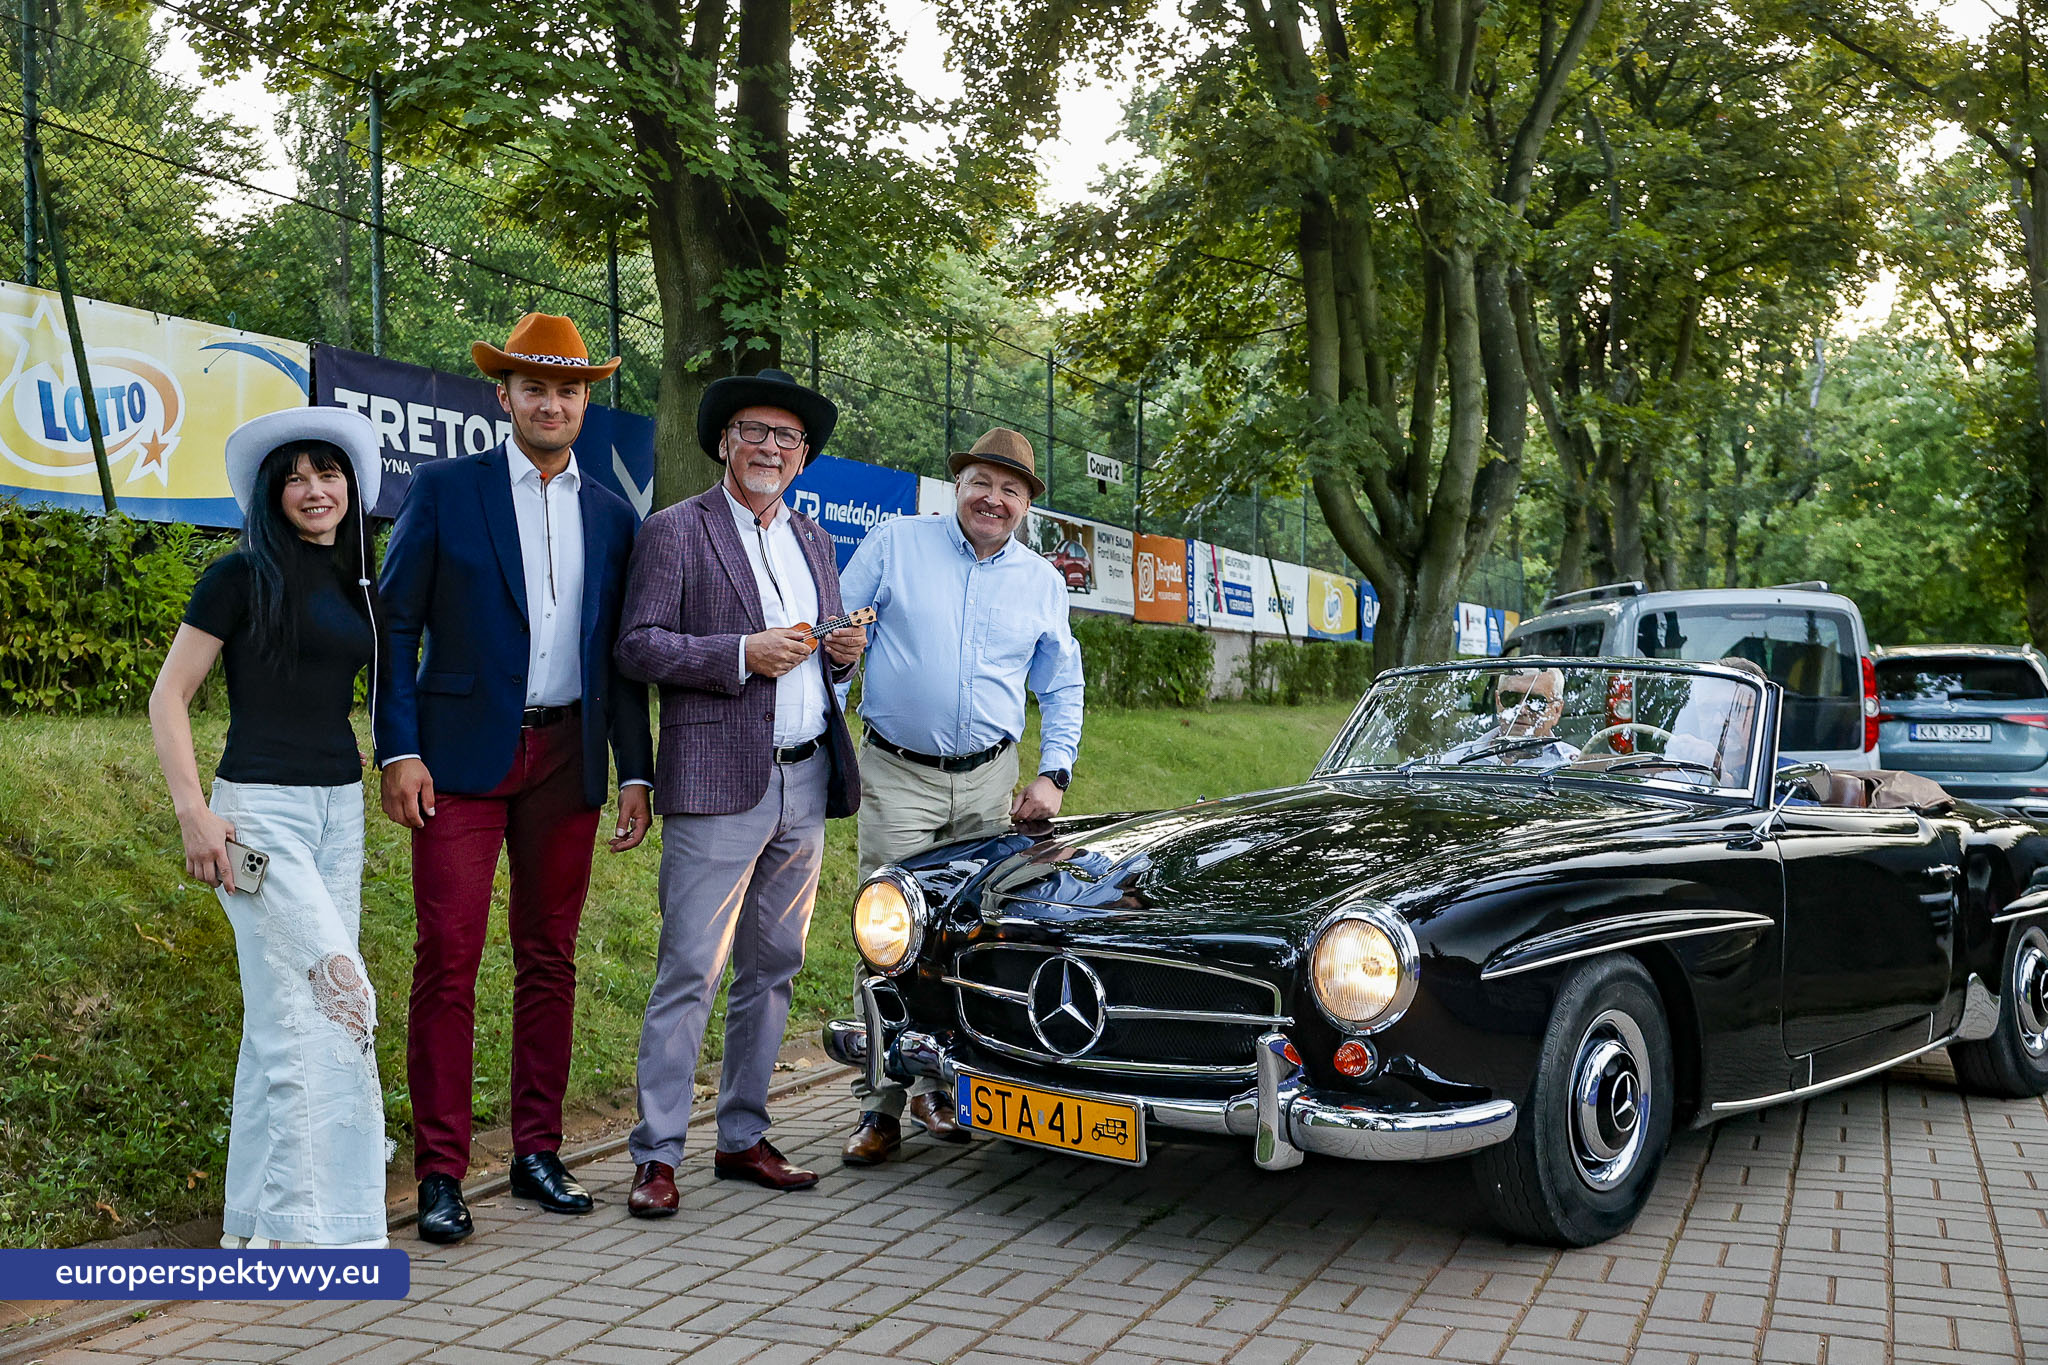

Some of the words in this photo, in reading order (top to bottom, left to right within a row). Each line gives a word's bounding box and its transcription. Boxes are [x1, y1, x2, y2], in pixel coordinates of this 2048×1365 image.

[37, 379, 146, 442] LOTTO
[1090, 456, 1113, 478] Court
[1114, 464, 1120, 480] 2
[1186, 543, 1195, 619] KSERO
[1920, 725, 1939, 739] KN
[960, 1104, 971, 1117] PL
[974, 1085, 1037, 1137] STA
[1048, 1101, 1084, 1145] 4J
